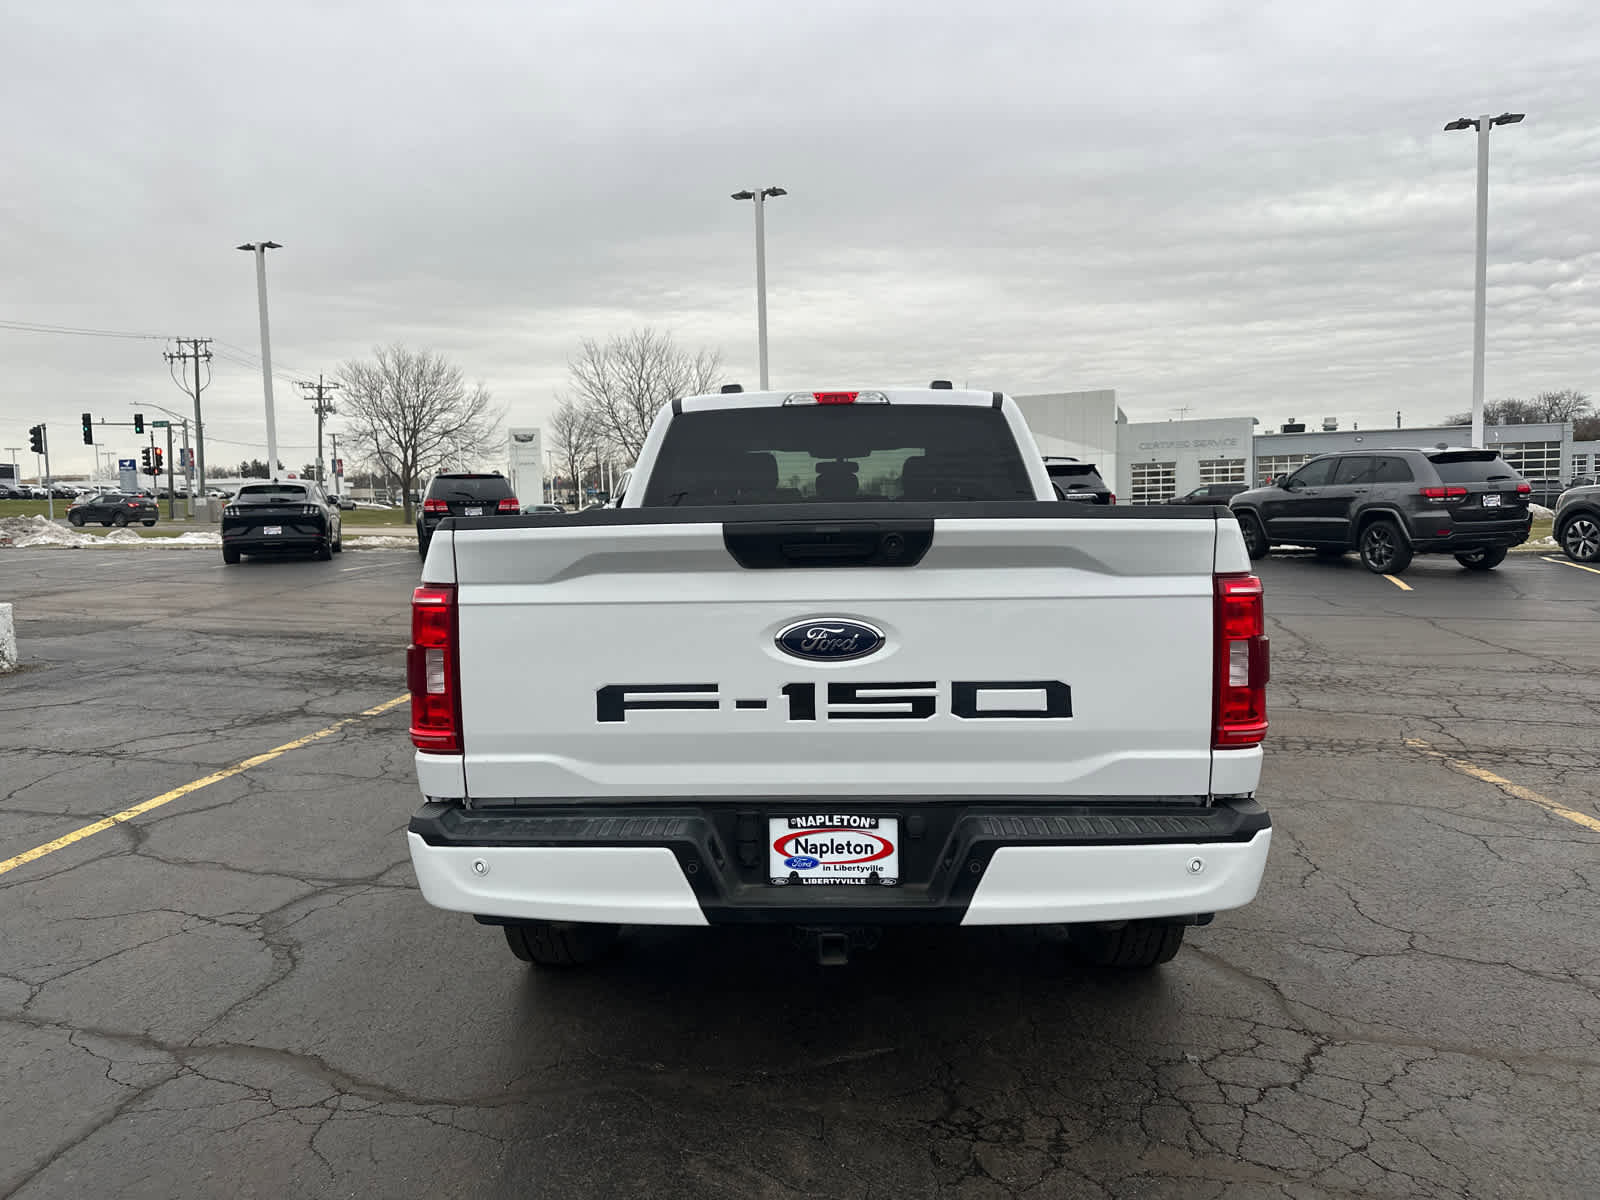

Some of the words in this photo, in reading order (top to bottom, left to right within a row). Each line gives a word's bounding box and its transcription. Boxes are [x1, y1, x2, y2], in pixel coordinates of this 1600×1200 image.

[801, 627, 860, 653] Ford
[596, 680, 1073, 722] F-150
[796, 815, 871, 827] NAPLETON
[794, 838, 874, 858] Napleton
[792, 858, 813, 868] Ford
[833, 864, 884, 872] Libertyville
